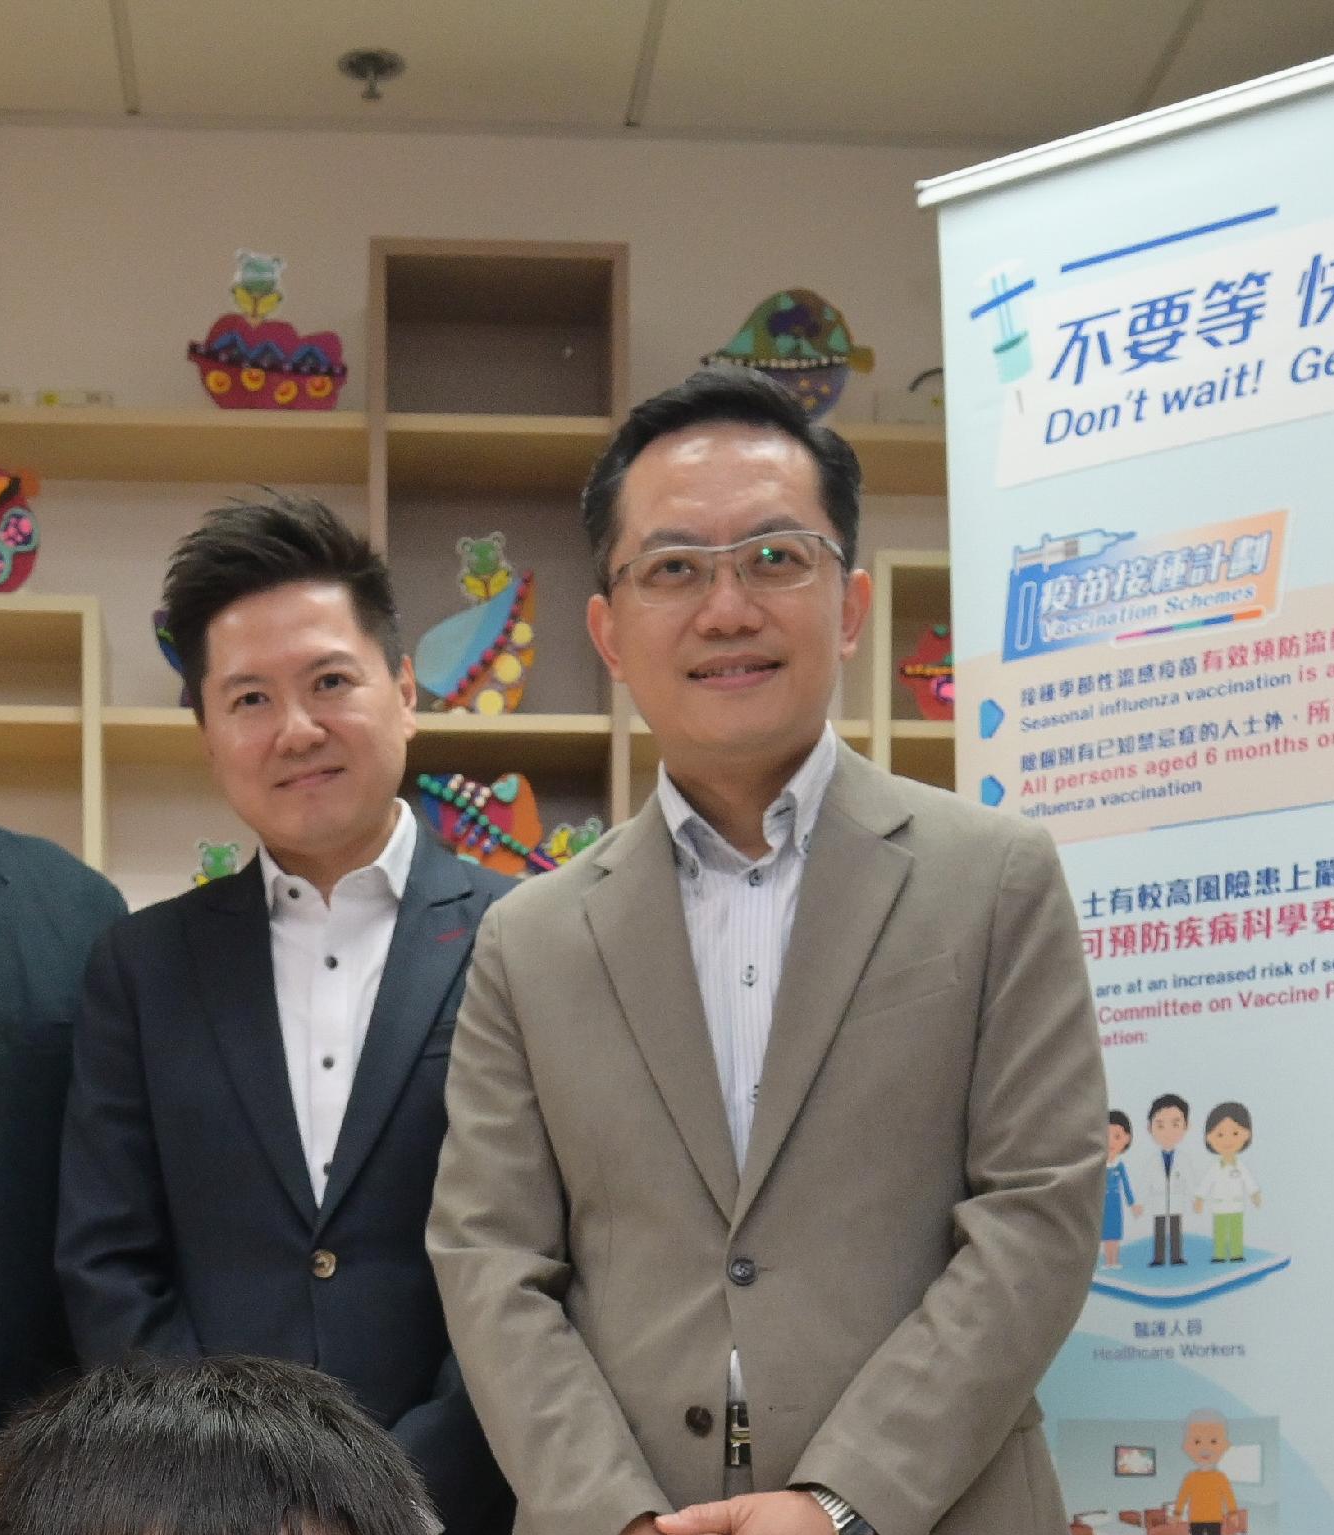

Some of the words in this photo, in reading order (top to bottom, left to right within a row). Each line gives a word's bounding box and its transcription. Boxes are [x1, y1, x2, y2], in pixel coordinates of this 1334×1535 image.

[1047, 271, 1274, 388] 不要等
[1044, 382, 1149, 447] Don't
[1161, 358, 1266, 417] wait!
[1040, 530, 1273, 614] 疫苗接種計劃
[1165, 584, 1256, 615] Schemes
[1020, 704, 1095, 732] Seasonal
[1099, 692, 1180, 717] influenza
[1185, 671, 1292, 702] vaccination
[1298, 662, 1317, 683] is
[1021, 777, 1047, 798] All
[1054, 763, 1138, 795] persons
[1146, 750, 1199, 777] aged
[1206, 749, 1218, 766] 6
[1225, 735, 1309, 763] months
[1101, 778, 1203, 807] vaccination
[1095, 982, 1122, 999] are
[1127, 979, 1143, 995] at
[1147, 979, 1167, 993] an
[1172, 966, 1257, 990] increased
[1260, 962, 1294, 979] risk
[1299, 958, 1316, 975] of
[1098, 998, 1202, 1025] Committee
[1208, 997, 1232, 1013] on
[1238, 984, 1320, 1010] Vaccine
[1100, 1030, 1149, 1048] ation:
[1178, 1343, 1246, 1358] Workers
